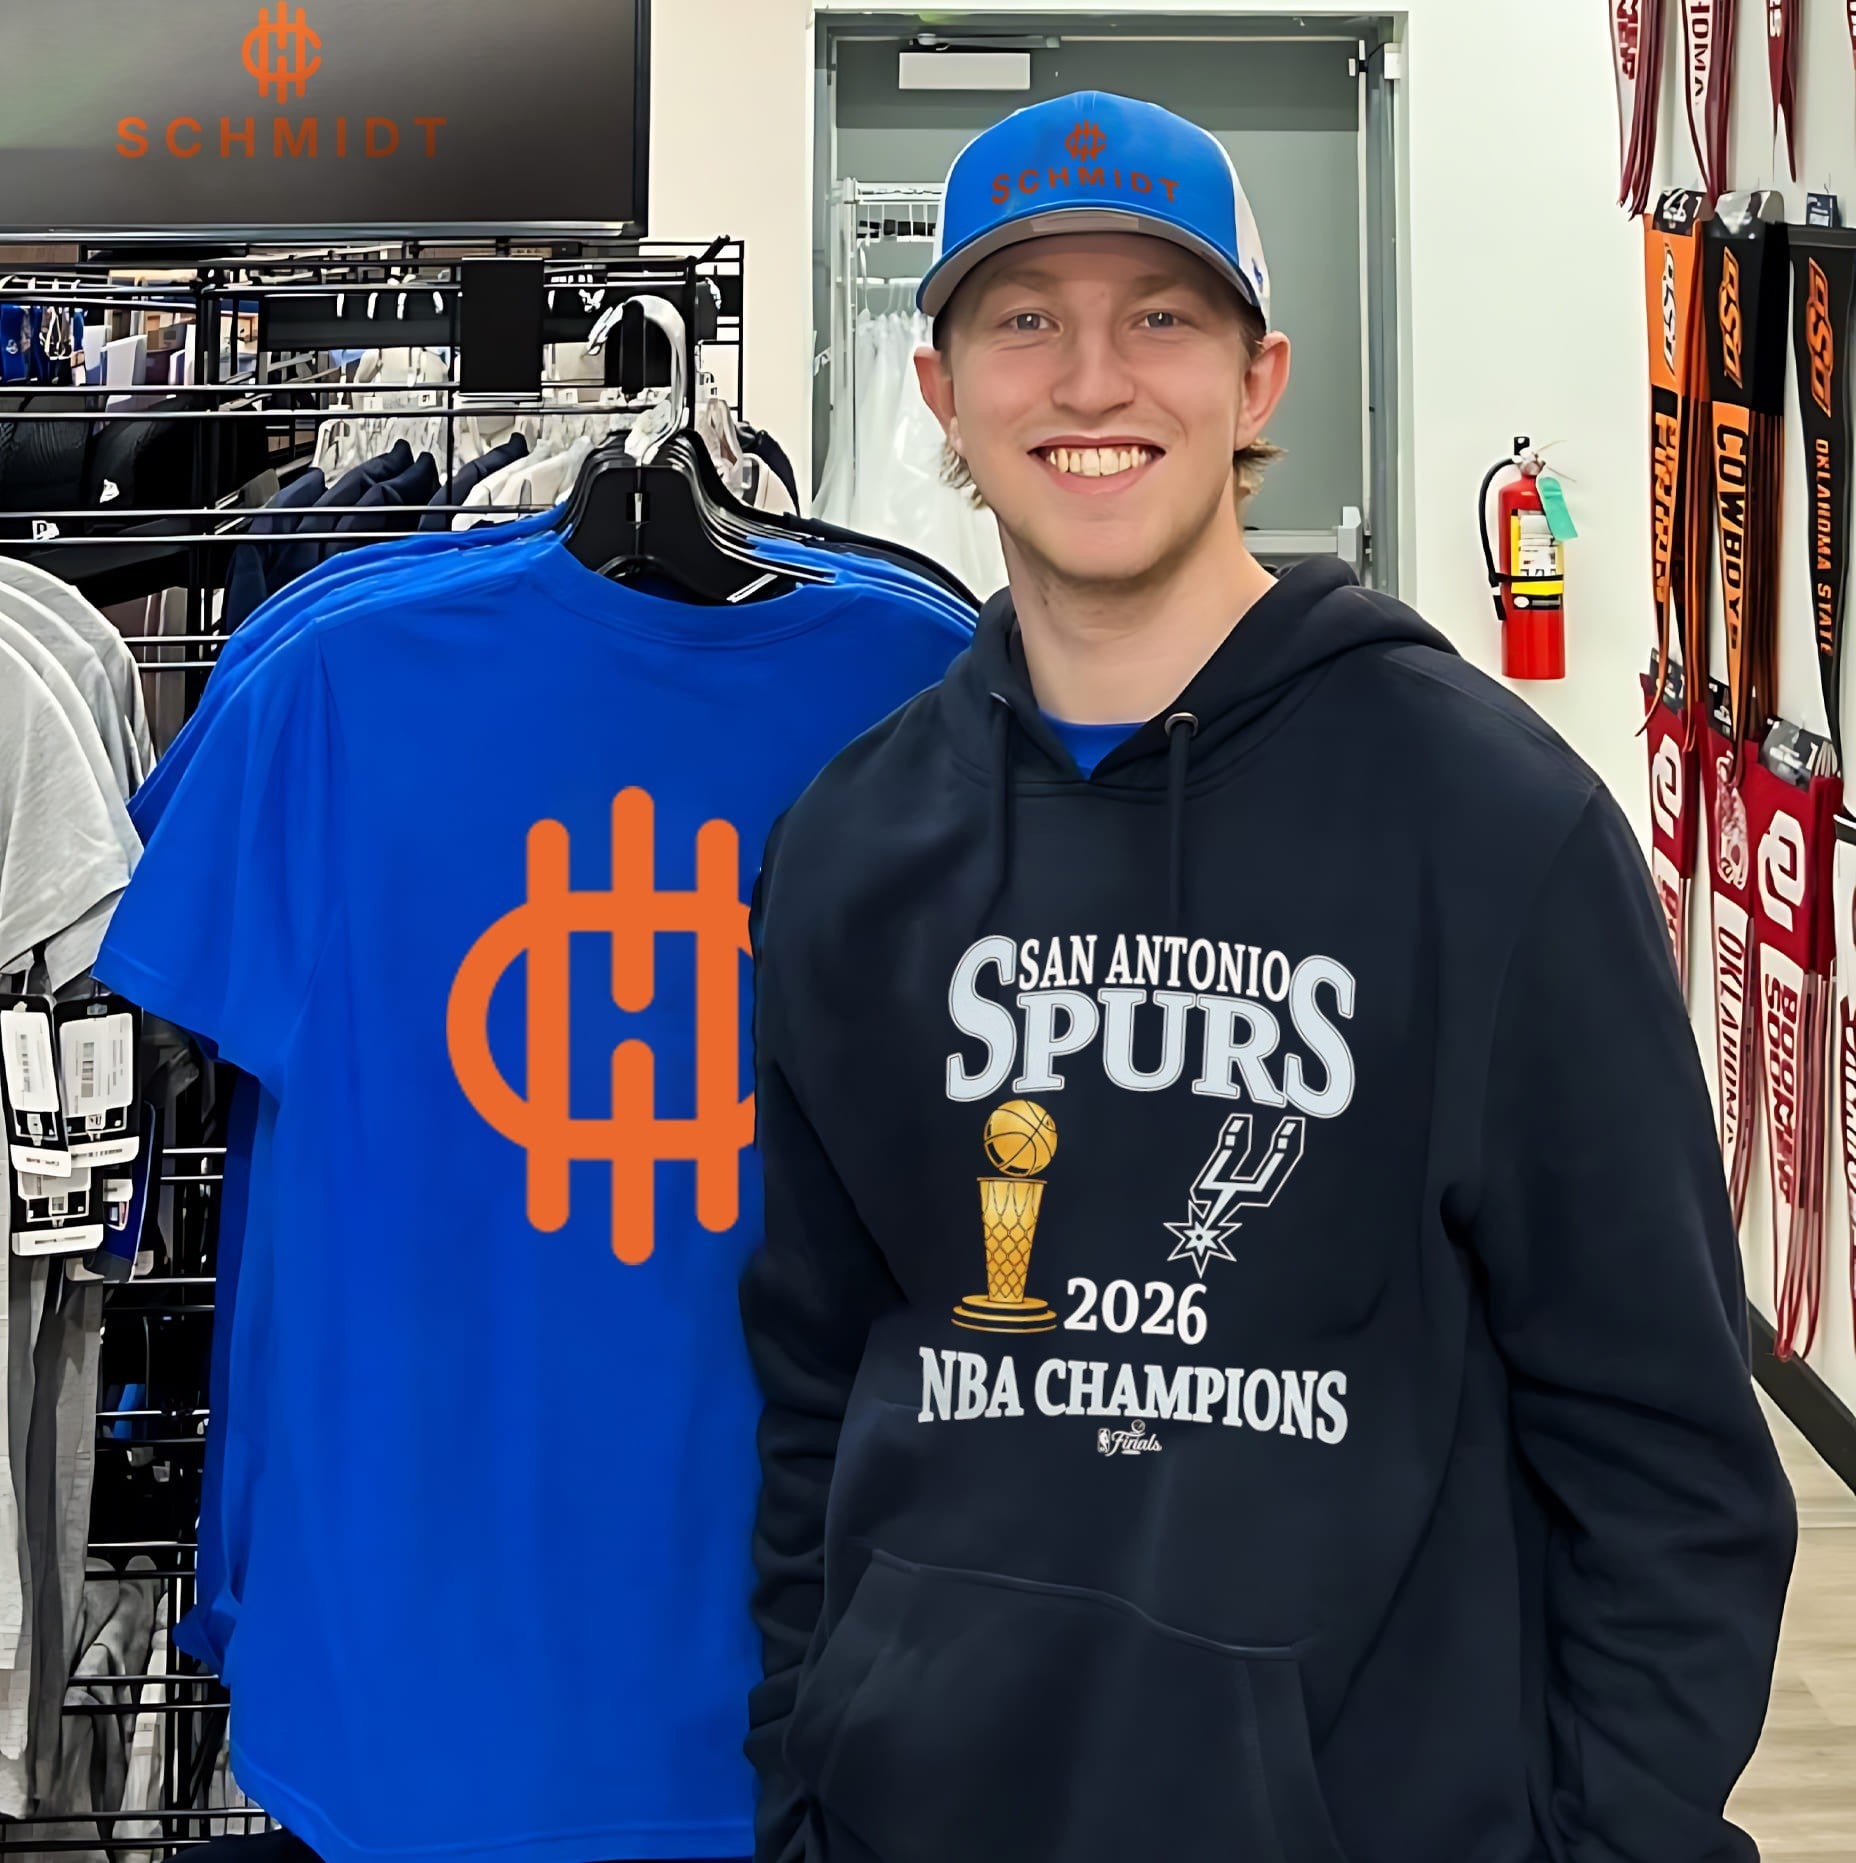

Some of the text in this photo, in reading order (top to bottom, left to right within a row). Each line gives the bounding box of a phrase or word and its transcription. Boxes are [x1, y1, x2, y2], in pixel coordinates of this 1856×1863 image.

[115, 117, 447, 158] SCHMIDT
[991, 167, 1179, 205] SCHMIDT
[1018, 934, 1290, 1001] SAN ANTONIO
[946, 935, 1356, 1119] SPURS
[1063, 1277, 1208, 1345] 2026
[918, 1346, 1348, 1445] NBA CHAMPIONS
[1105, 1430, 1163, 1457] Finals
